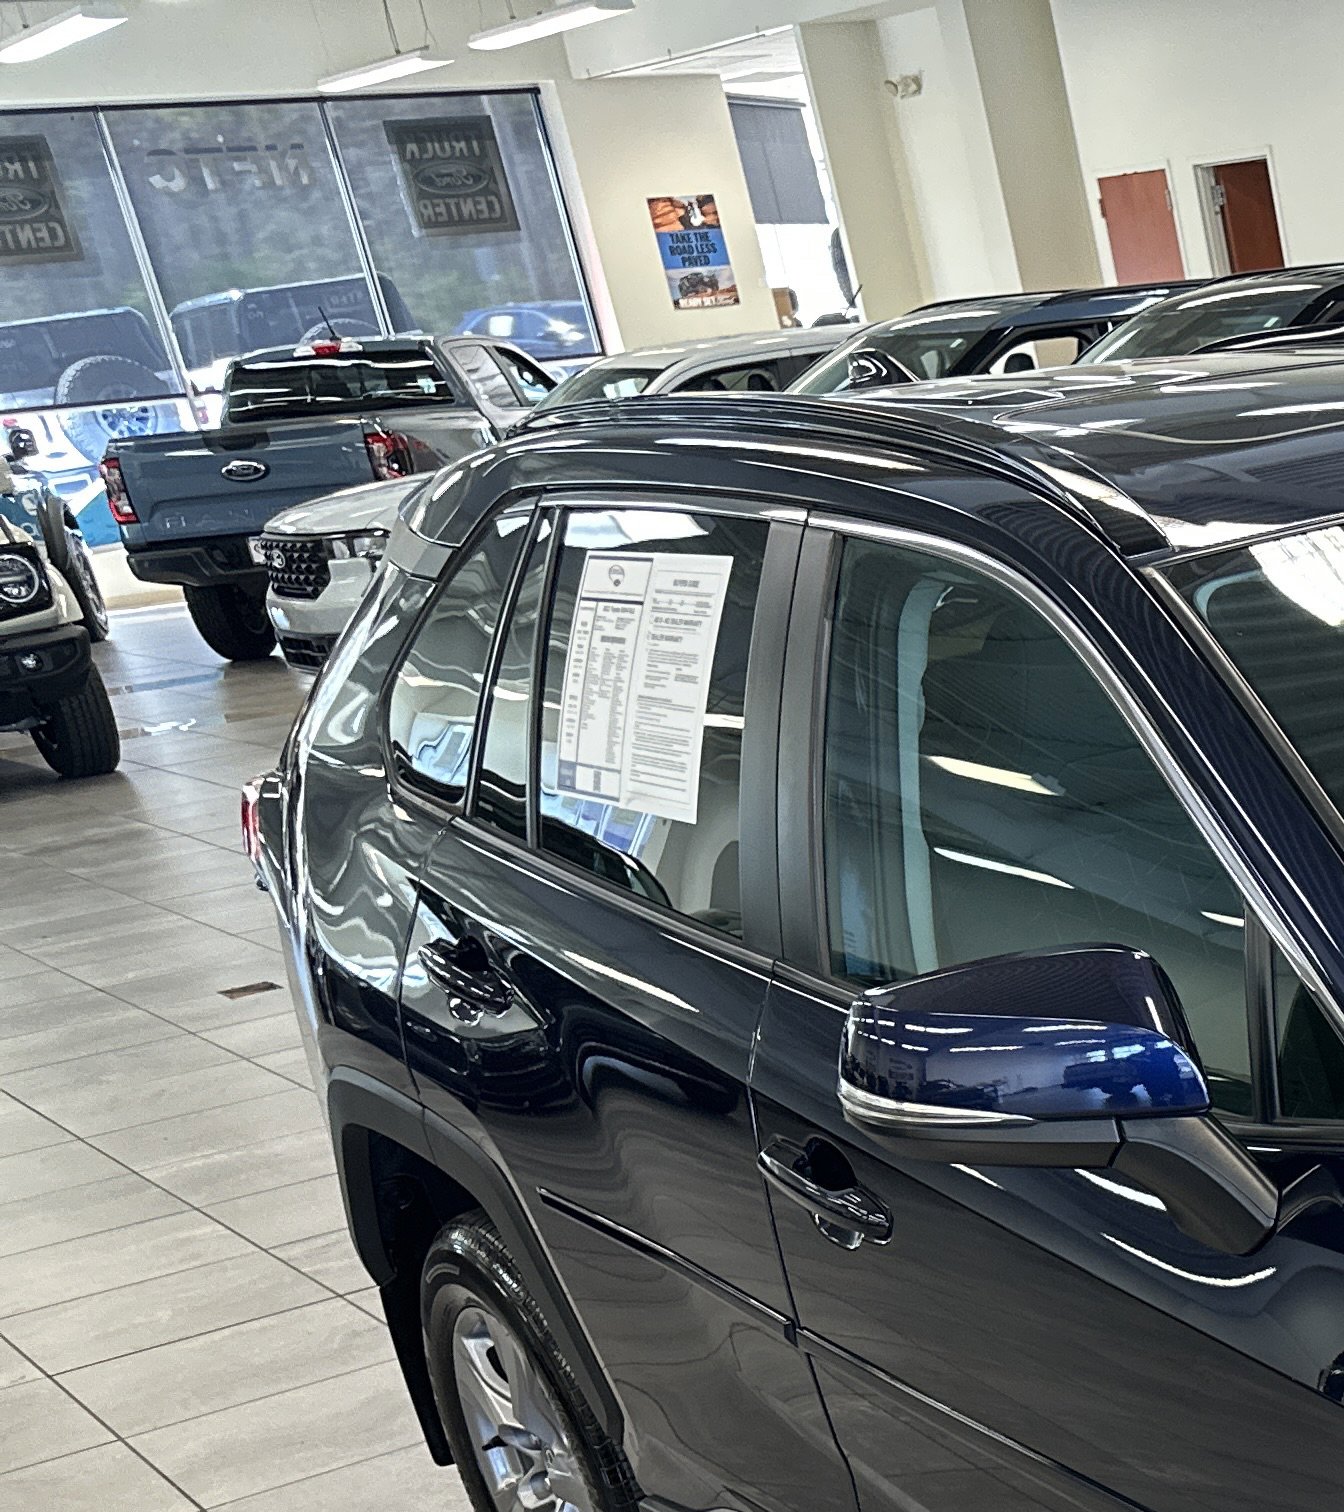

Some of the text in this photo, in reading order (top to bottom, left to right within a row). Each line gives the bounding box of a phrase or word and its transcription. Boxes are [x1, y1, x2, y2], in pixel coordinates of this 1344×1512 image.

[669, 232, 711, 244] TAKE THE
[668, 242, 718, 256] ROAD LESS
